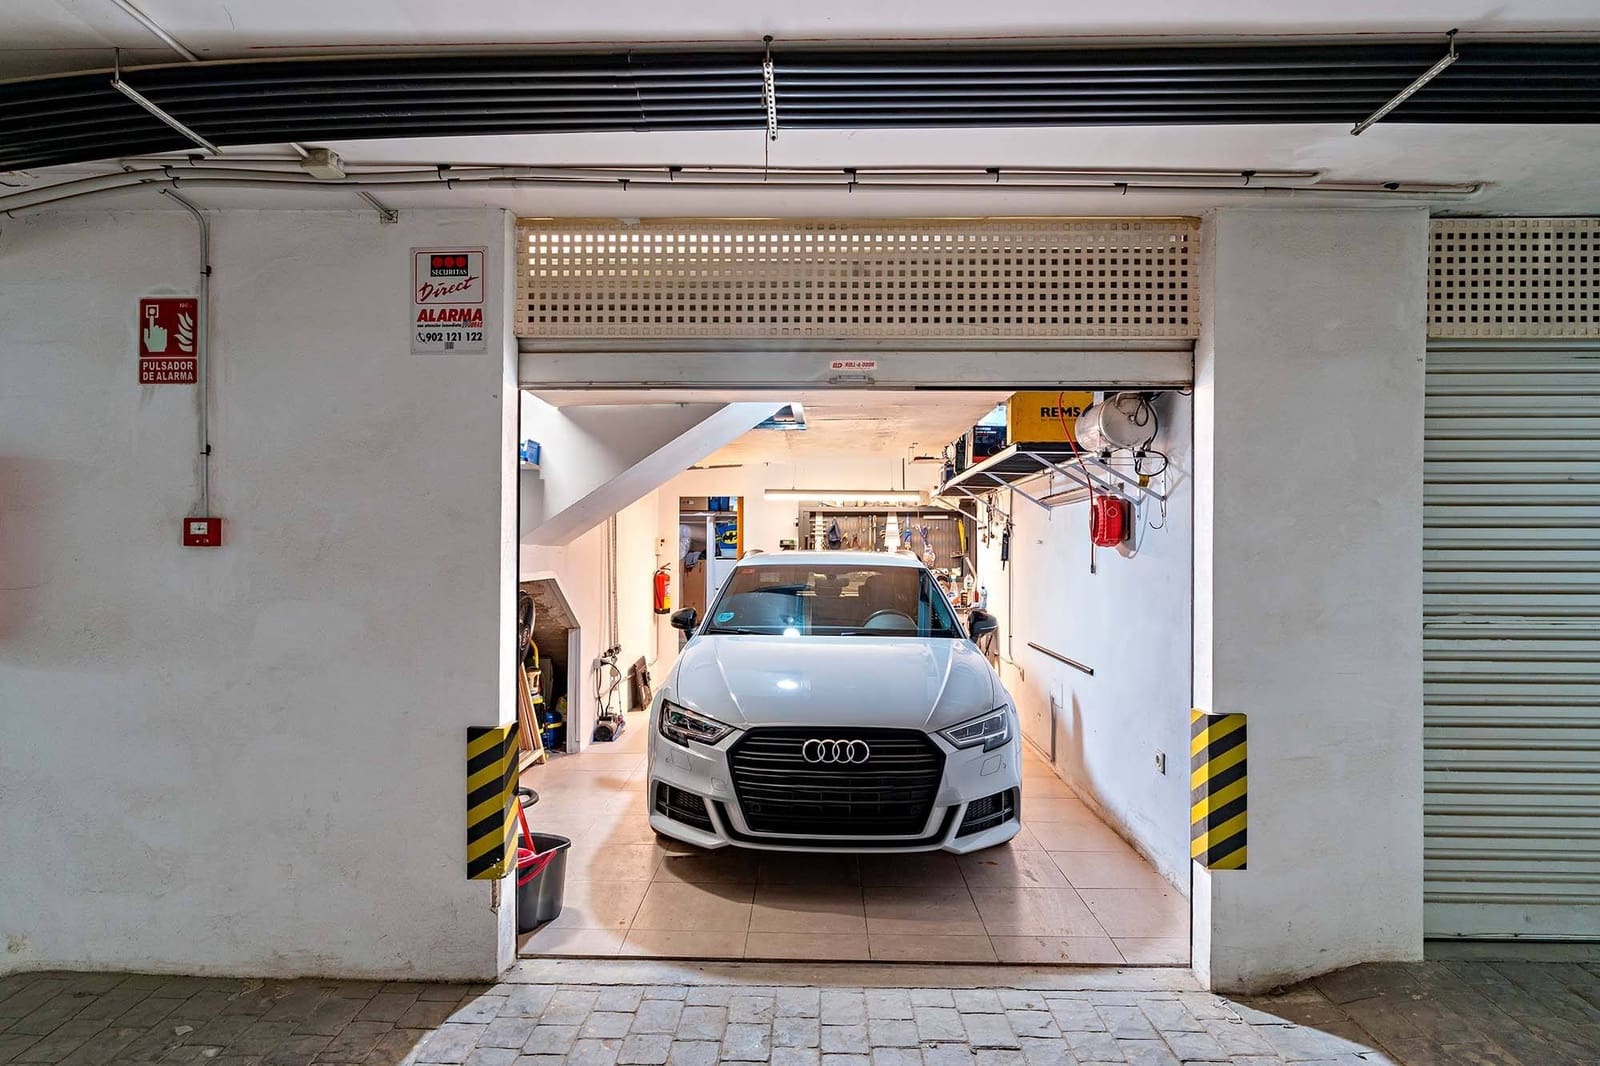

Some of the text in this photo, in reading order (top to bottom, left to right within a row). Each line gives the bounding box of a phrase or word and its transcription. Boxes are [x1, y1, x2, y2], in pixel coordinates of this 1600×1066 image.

[431, 268, 467, 276] SECURITAS
[418, 275, 479, 302] Direct
[416, 308, 483, 322] ALARMA
[426, 332, 483, 341] 902 121 122
[143, 361, 193, 370] PULSADOR
[143, 371, 194, 381] DE ALARMA
[1040, 407, 1081, 417] REMS
